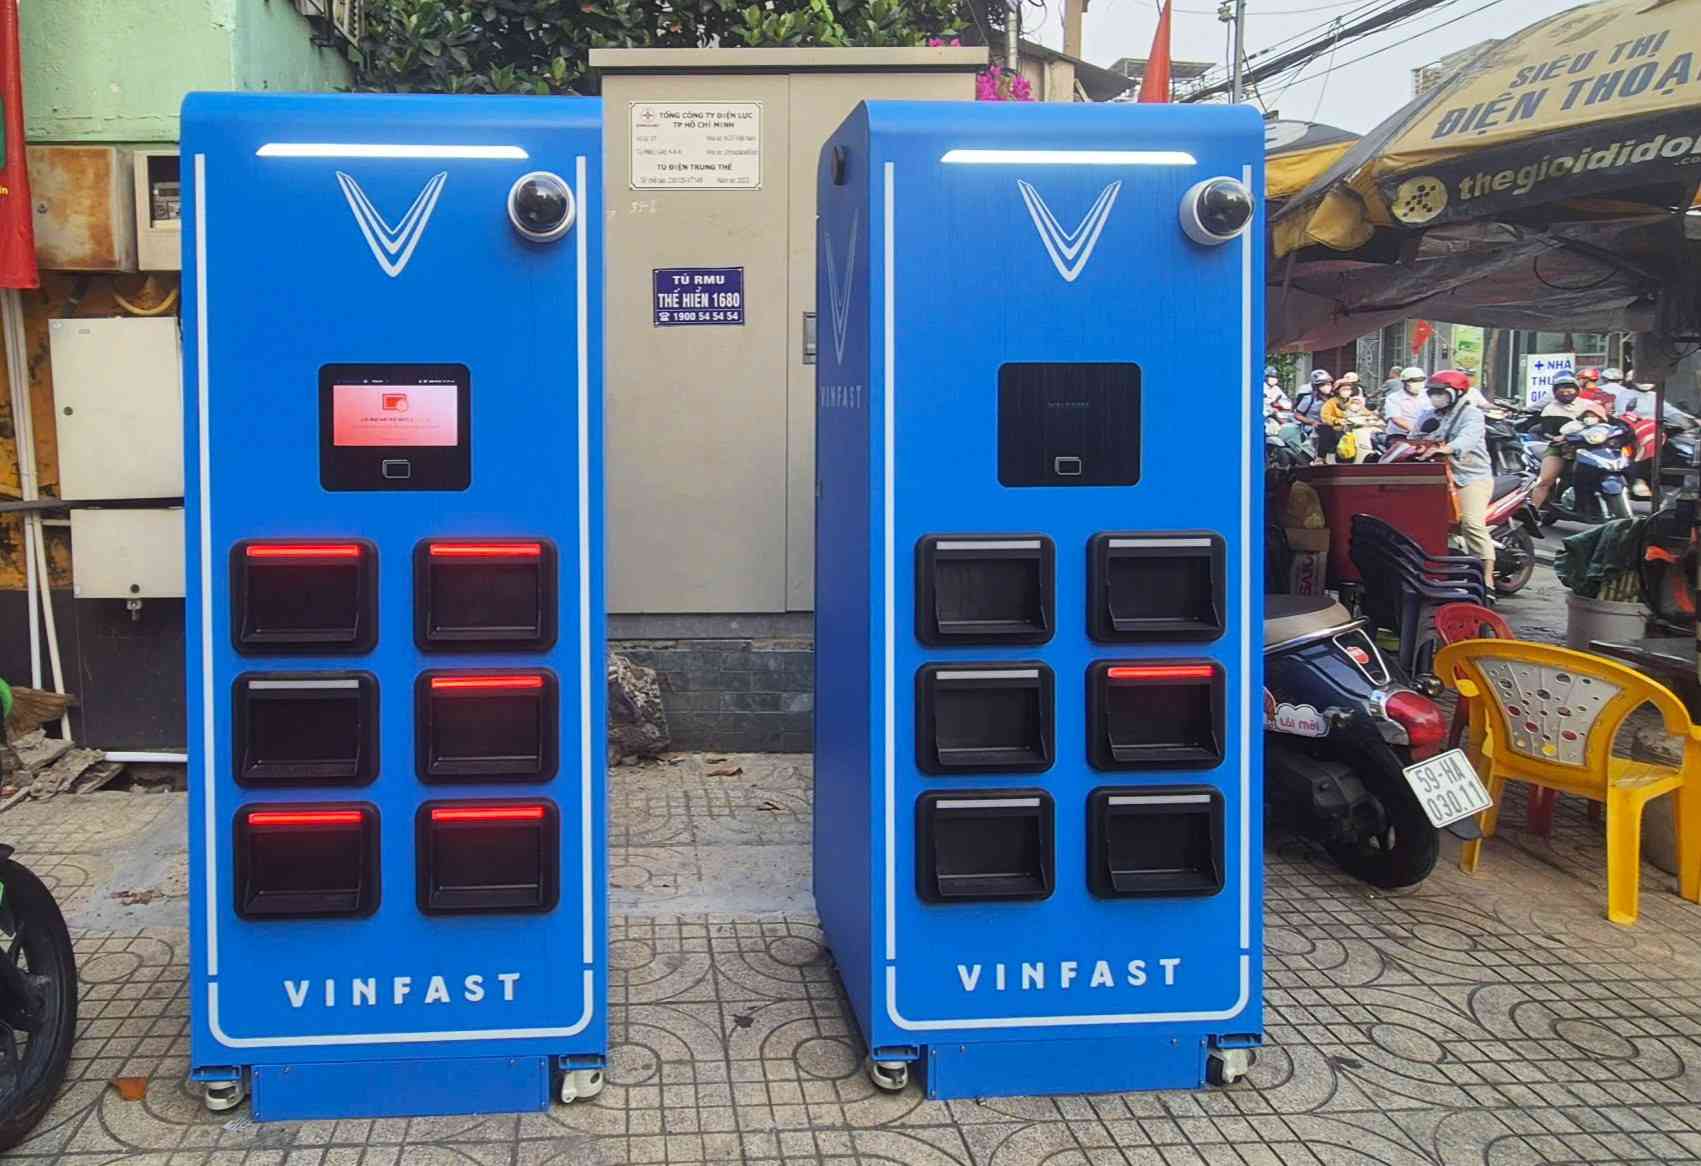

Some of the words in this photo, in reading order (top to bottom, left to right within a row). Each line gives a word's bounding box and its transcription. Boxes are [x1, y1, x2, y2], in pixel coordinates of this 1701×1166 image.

[1509, 50, 1599, 88] SIÊU
[1608, 29, 1670, 64] THỊ
[682, 111, 704, 119] CÔNG
[1431, 87, 1549, 140] ĐIỆN
[672, 272, 690, 285] TỦ
[694, 275, 725, 285] RMU
[658, 287, 680, 308] THẾ
[682, 286, 709, 308] HIỂN
[711, 292, 740, 308] 1680
[673, 312, 696, 321] 1900
[698, 312, 710, 321] 54
[712, 312, 724, 321] 54
[726, 311, 739, 321] 54
[1414, 756, 1466, 793] 59-HA
[283, 972, 521, 1008] VINFAST
[957, 957, 1182, 992] VINFAST
